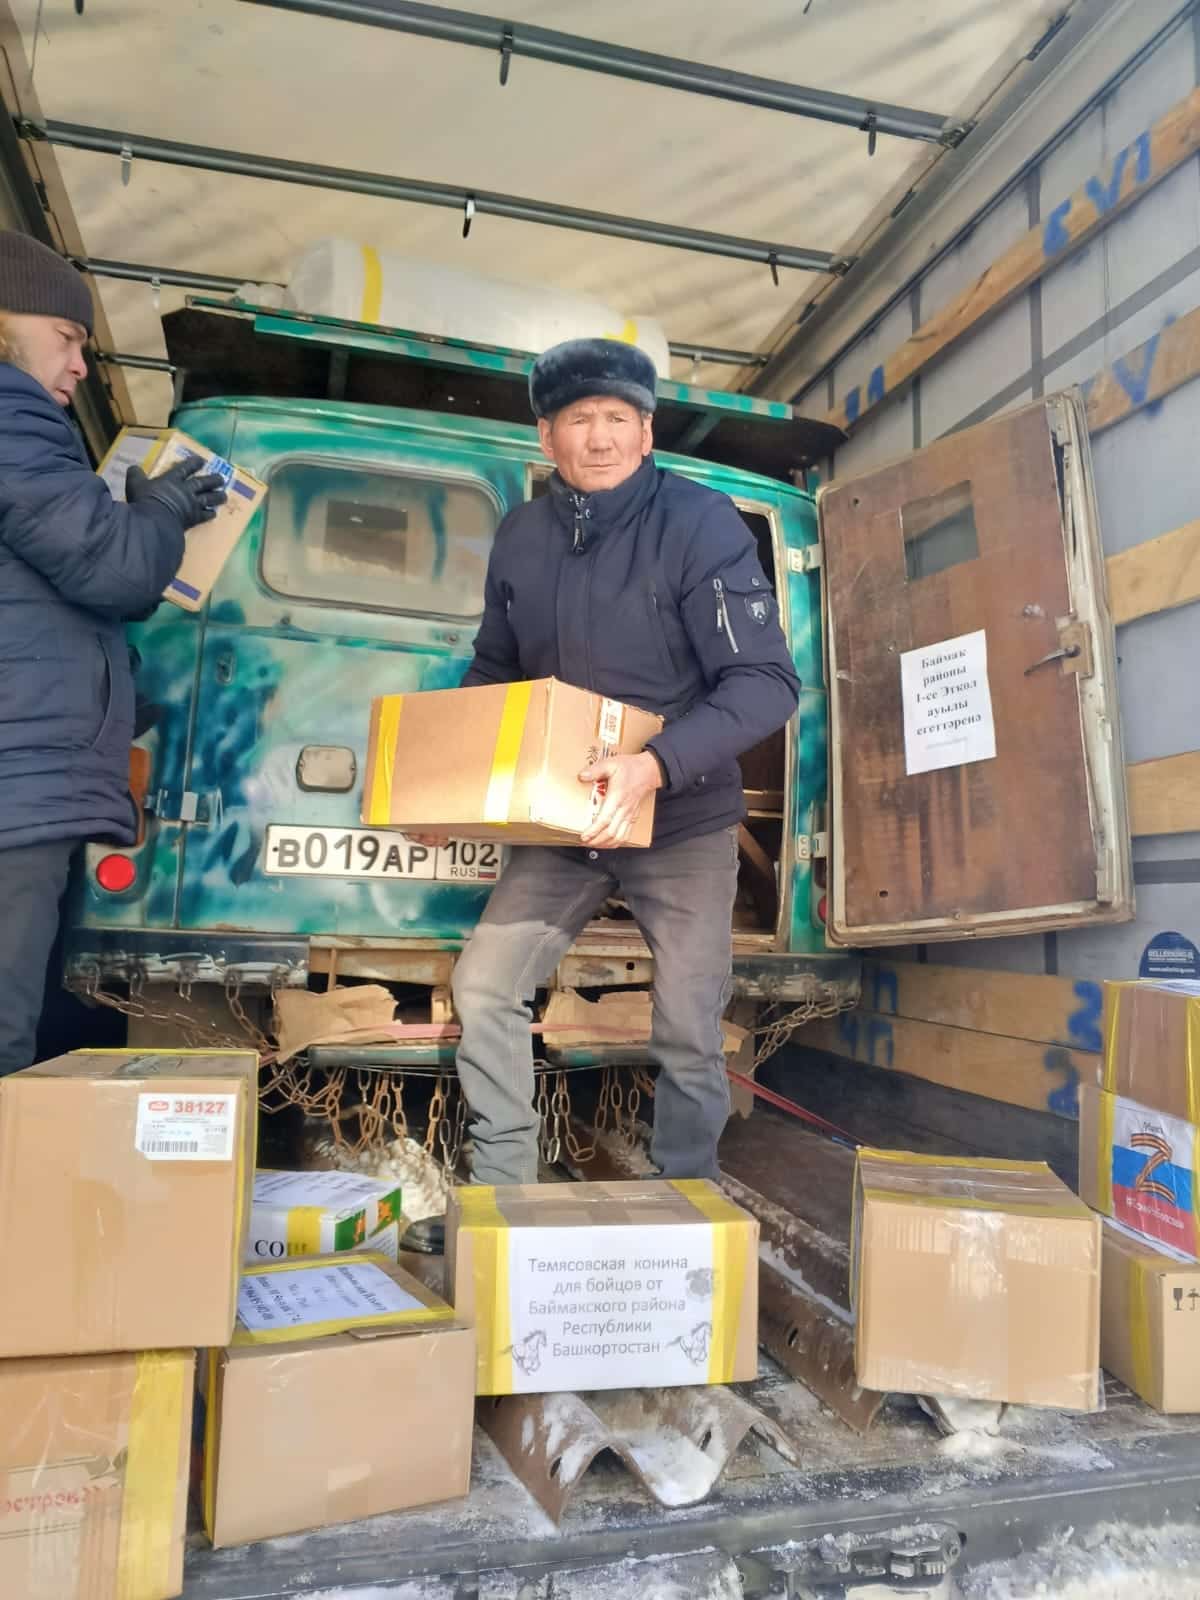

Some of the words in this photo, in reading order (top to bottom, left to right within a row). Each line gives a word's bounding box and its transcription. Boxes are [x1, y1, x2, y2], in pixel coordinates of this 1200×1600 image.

[444, 840, 498, 866] 102
[449, 867, 476, 878] RUS
[175, 1101, 225, 1114] 38127
[528, 1257, 625, 1273] Темясовская
[634, 1256, 688, 1270] конина
[553, 1280, 581, 1295] для
[586, 1276, 642, 1294] бойцов
[646, 1278, 663, 1290] от
[528, 1299, 627, 1315] Баймакского
[631, 1297, 686, 1314] района
[562, 1319, 652, 1336] Республики
[552, 1341, 660, 1358] Башкортостан
